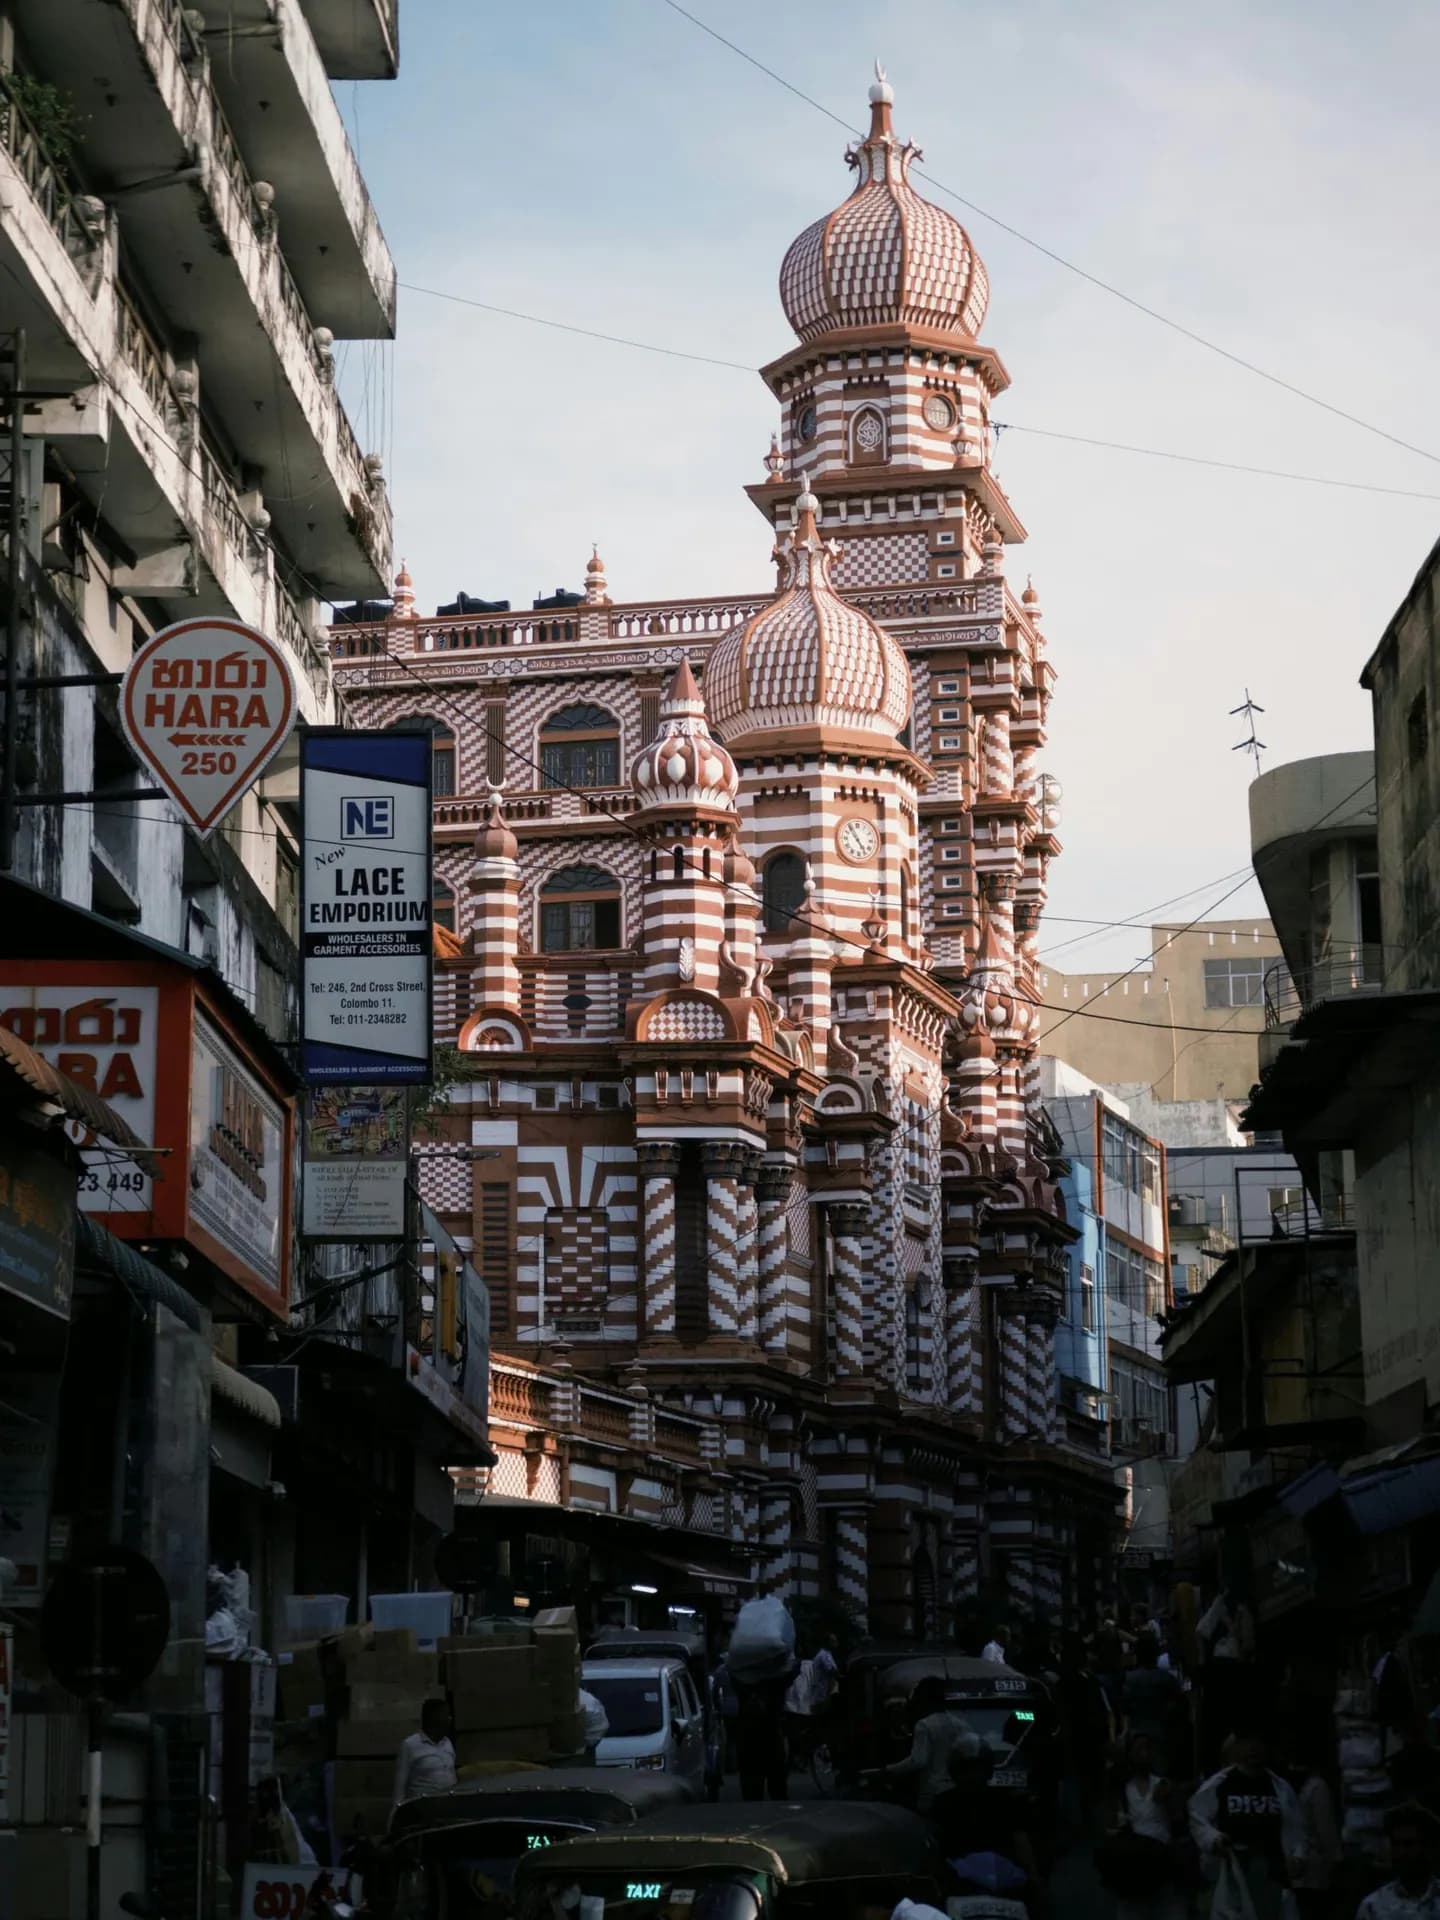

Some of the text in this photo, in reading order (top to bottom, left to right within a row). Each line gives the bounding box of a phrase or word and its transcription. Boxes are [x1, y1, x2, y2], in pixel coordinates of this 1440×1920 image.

[144, 694, 270, 728] HARA
[181, 752, 236, 775] 250
[314, 845, 346, 870] New
[335, 867, 405, 896] LACE
[310, 901, 428, 923] EMPORIUM
[328, 933, 407, 944] WHOLESALERS IN
[313, 944, 421, 955] GARMENT ACCESSORIES
[310, 983, 326, 993] Tel:
[350, 982, 367, 993] 2nd
[369, 982, 394, 992] Cross
[341, 998, 379, 1009] Colombo
[329, 1014, 345, 1025] Tel:
[107, 1173, 144, 1191] 449
[625, 1882, 662, 1899] TAXI
